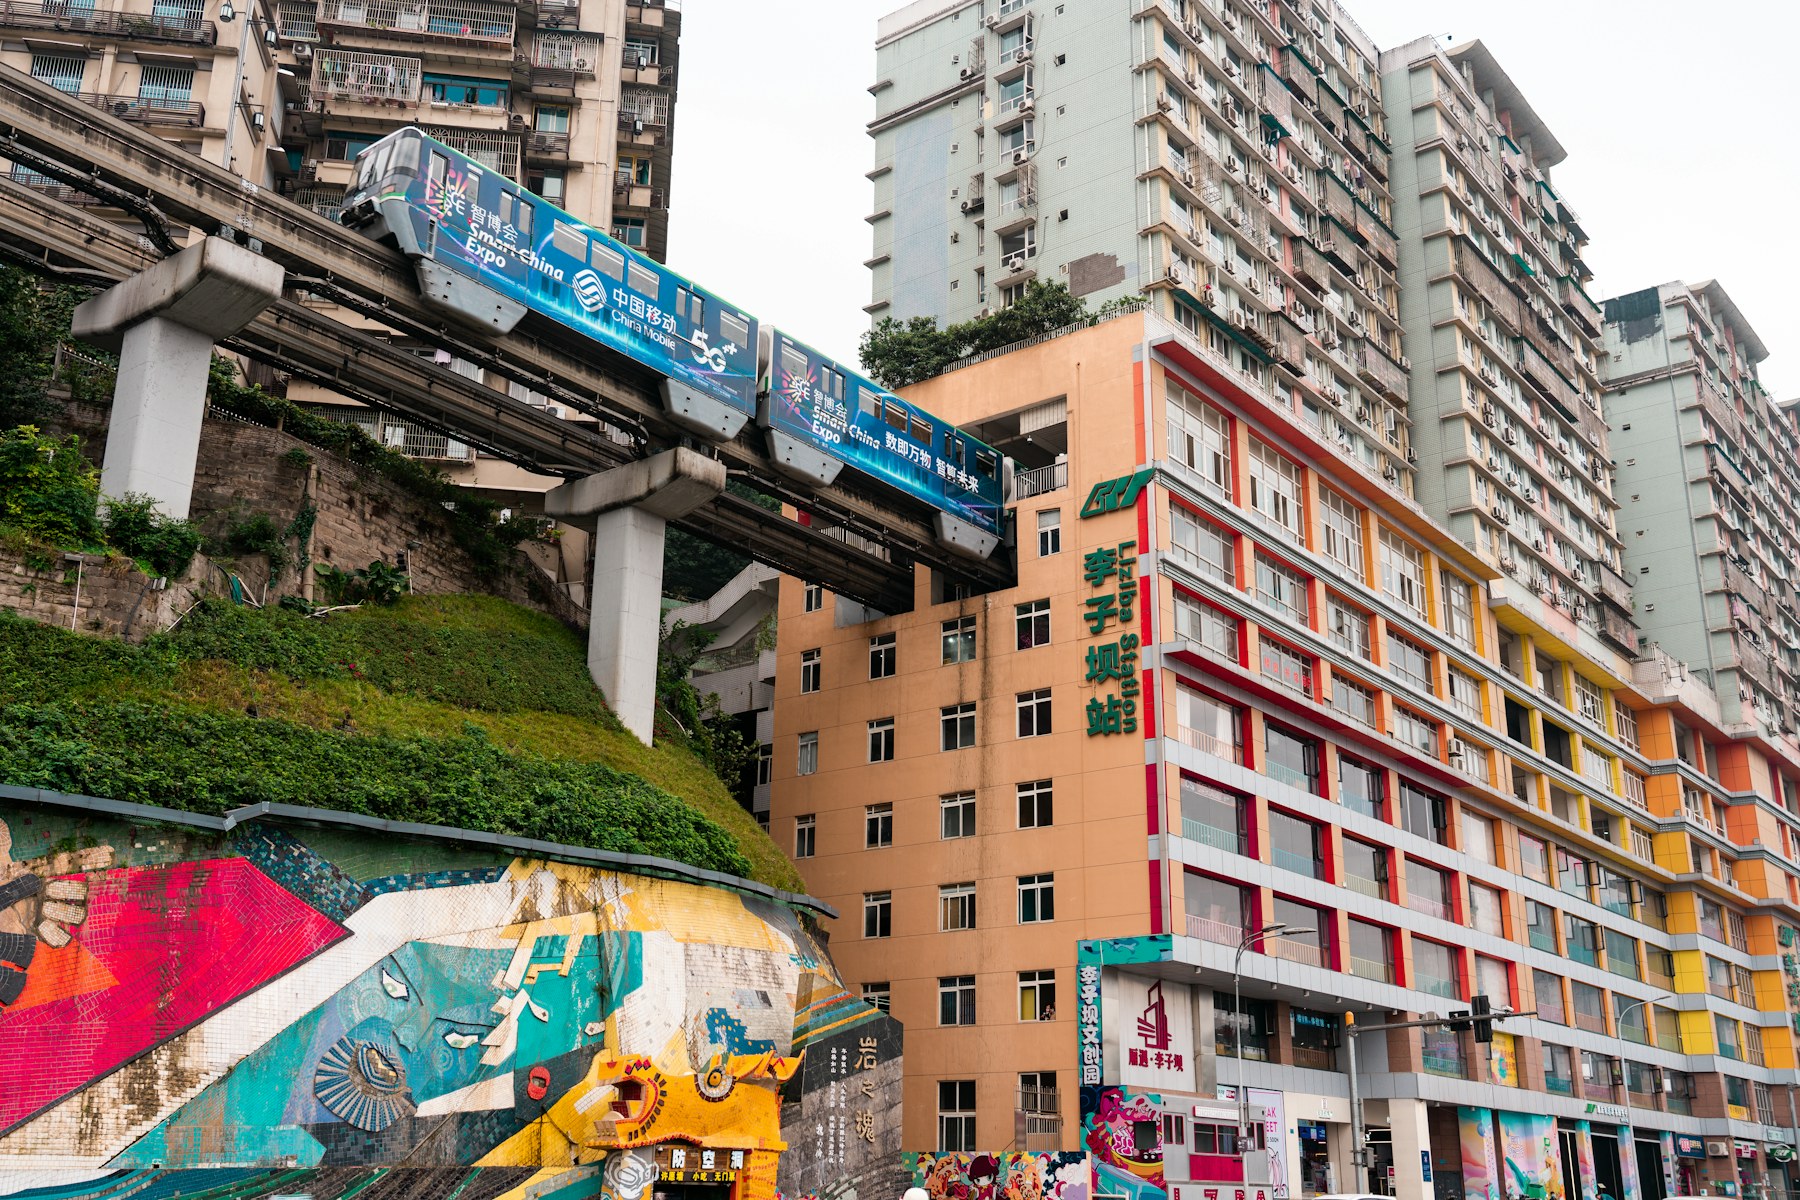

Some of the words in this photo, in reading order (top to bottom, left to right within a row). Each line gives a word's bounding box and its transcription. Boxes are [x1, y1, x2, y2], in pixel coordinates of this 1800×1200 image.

[471, 203, 518, 243] 智博会
[465, 235, 506, 268] Expo
[468, 222, 518, 258] Smart
[519, 248, 564, 281] China
[611, 309, 642, 333] China
[643, 325, 676, 351] Mobile
[613, 288, 677, 335] 中国移动
[812, 405, 848, 433] Smart
[849, 424, 880, 450] China
[814, 388, 848, 421] 智博会
[812, 420, 841, 444] Expo
[885, 430, 932, 469] 数即万物
[935, 457, 979, 494] 智算未来
[1118, 540, 1137, 623] Liziba
[1083, 547, 1122, 737] 李子坝站
[1119, 633, 1139, 734] Station
[1080, 965, 1100, 1085] 李子坝文创园
[853, 1036, 878, 1143] 岩之魂
[671, 1148, 744, 1170] 防空洞
[692, 1171, 708, 1182] 小吃
[714, 1171, 736, 1182] 无门票
